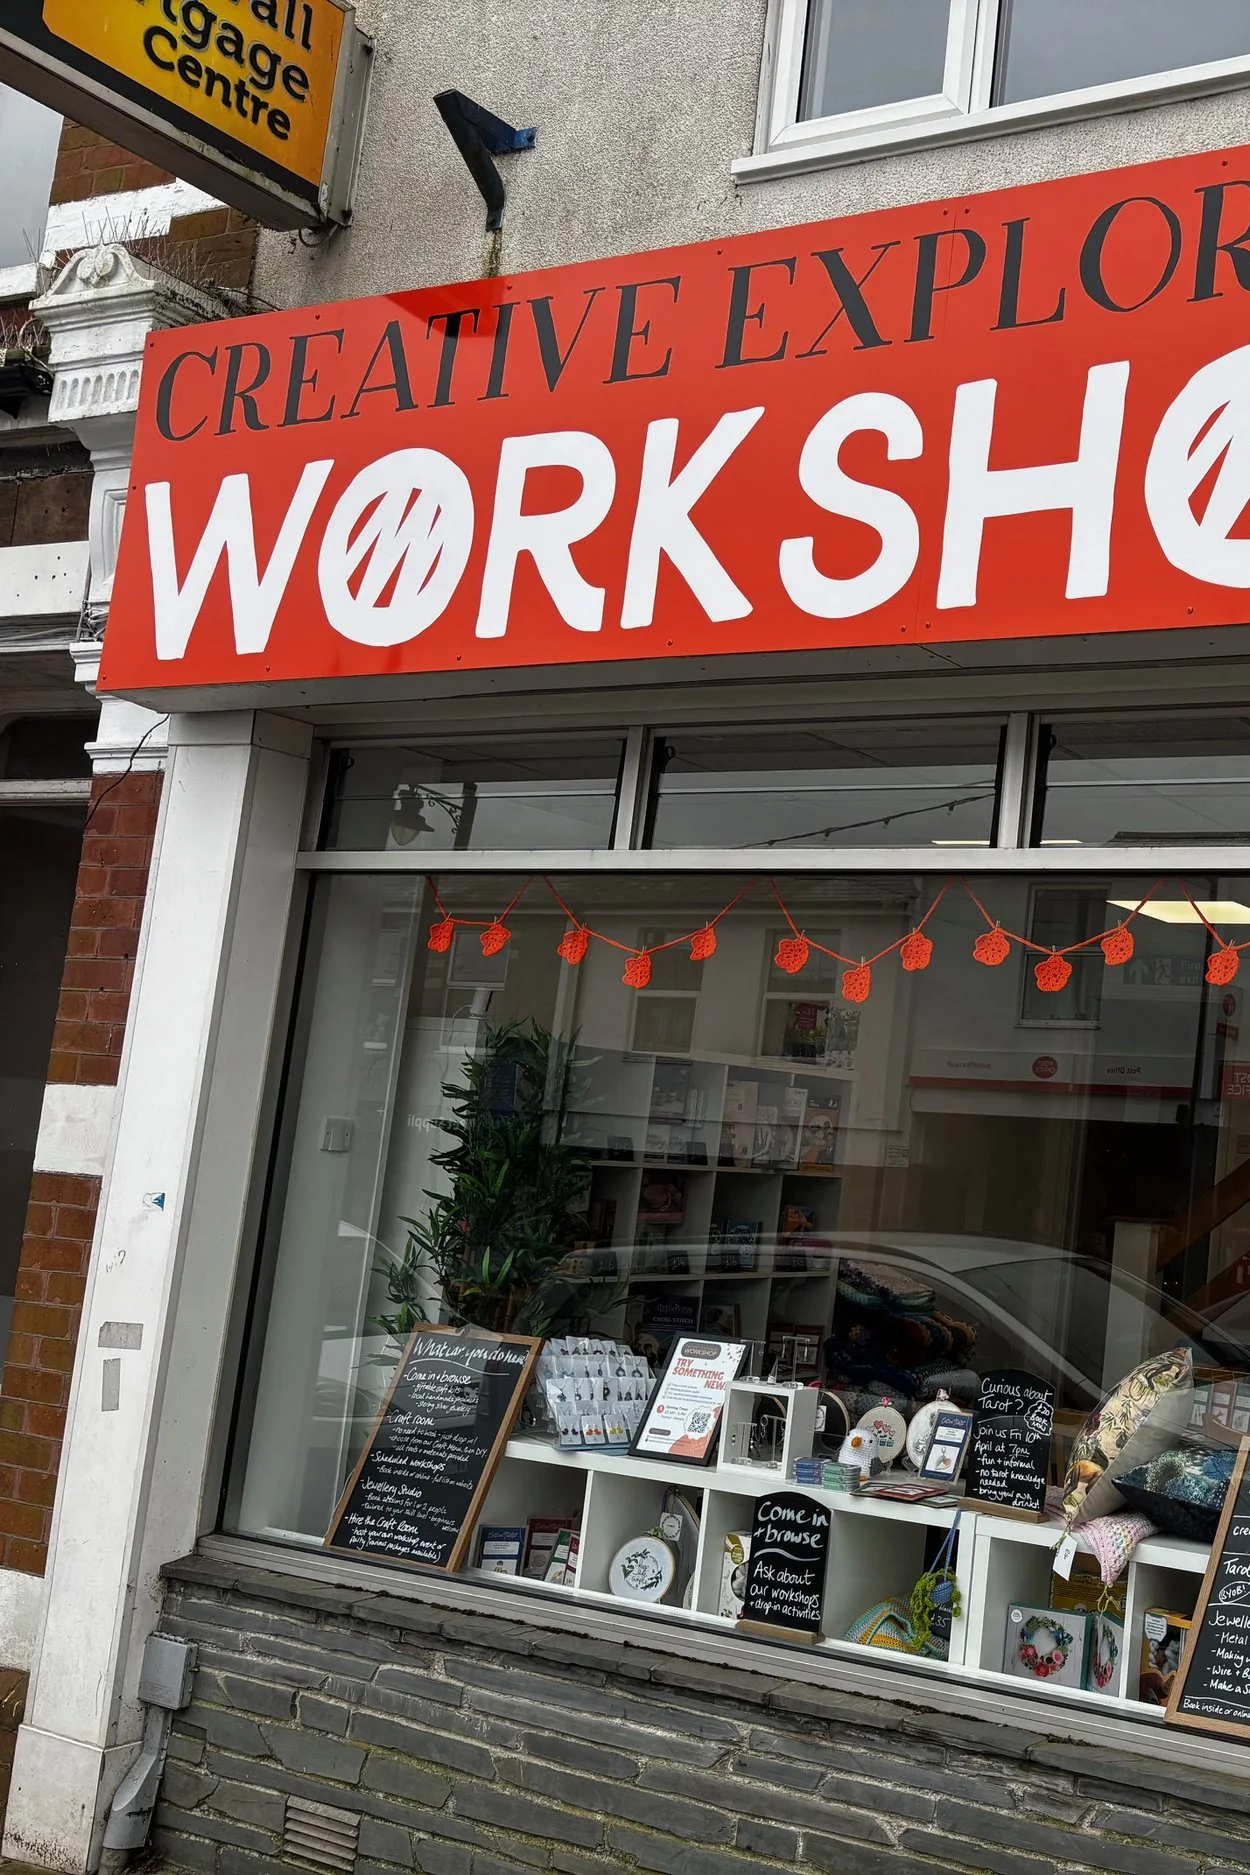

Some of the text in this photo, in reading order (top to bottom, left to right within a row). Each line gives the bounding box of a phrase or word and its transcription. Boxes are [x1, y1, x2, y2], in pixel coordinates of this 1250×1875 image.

[143, 25, 291, 141] Centre
[156, 276, 682, 442] CREATIVE
[413, 1336, 446, 1358] What
[490, 1346, 505, 1361] do
[672, 1366, 725, 1380] SOMETHING
[676, 1358, 694, 1368] TRY
[981, 1377, 1054, 1402] Curious about
[994, 1427, 1008, 1439] us
[1009, 1427, 1022, 1441] Fri
[974, 1440, 1030, 1458] April at 7pm
[1003, 1457, 1036, 1471] informal
[980, 1478, 1009, 1489] needed
[990, 1468, 1046, 1490] tarot knowledge
[757, 1501, 830, 1527] Come in
[764, 1523, 825, 1549] browse
[753, 1560, 816, 1586] Ask about
[750, 1583, 820, 1610] our workshops
[781, 1604, 821, 1621] activities
[1234, 1685, 1242, 1694] a
[1183, 1698, 1200, 1710] Book
[1201, 1702, 1224, 1715] inside
[1224, 1707, 1233, 1715] or
